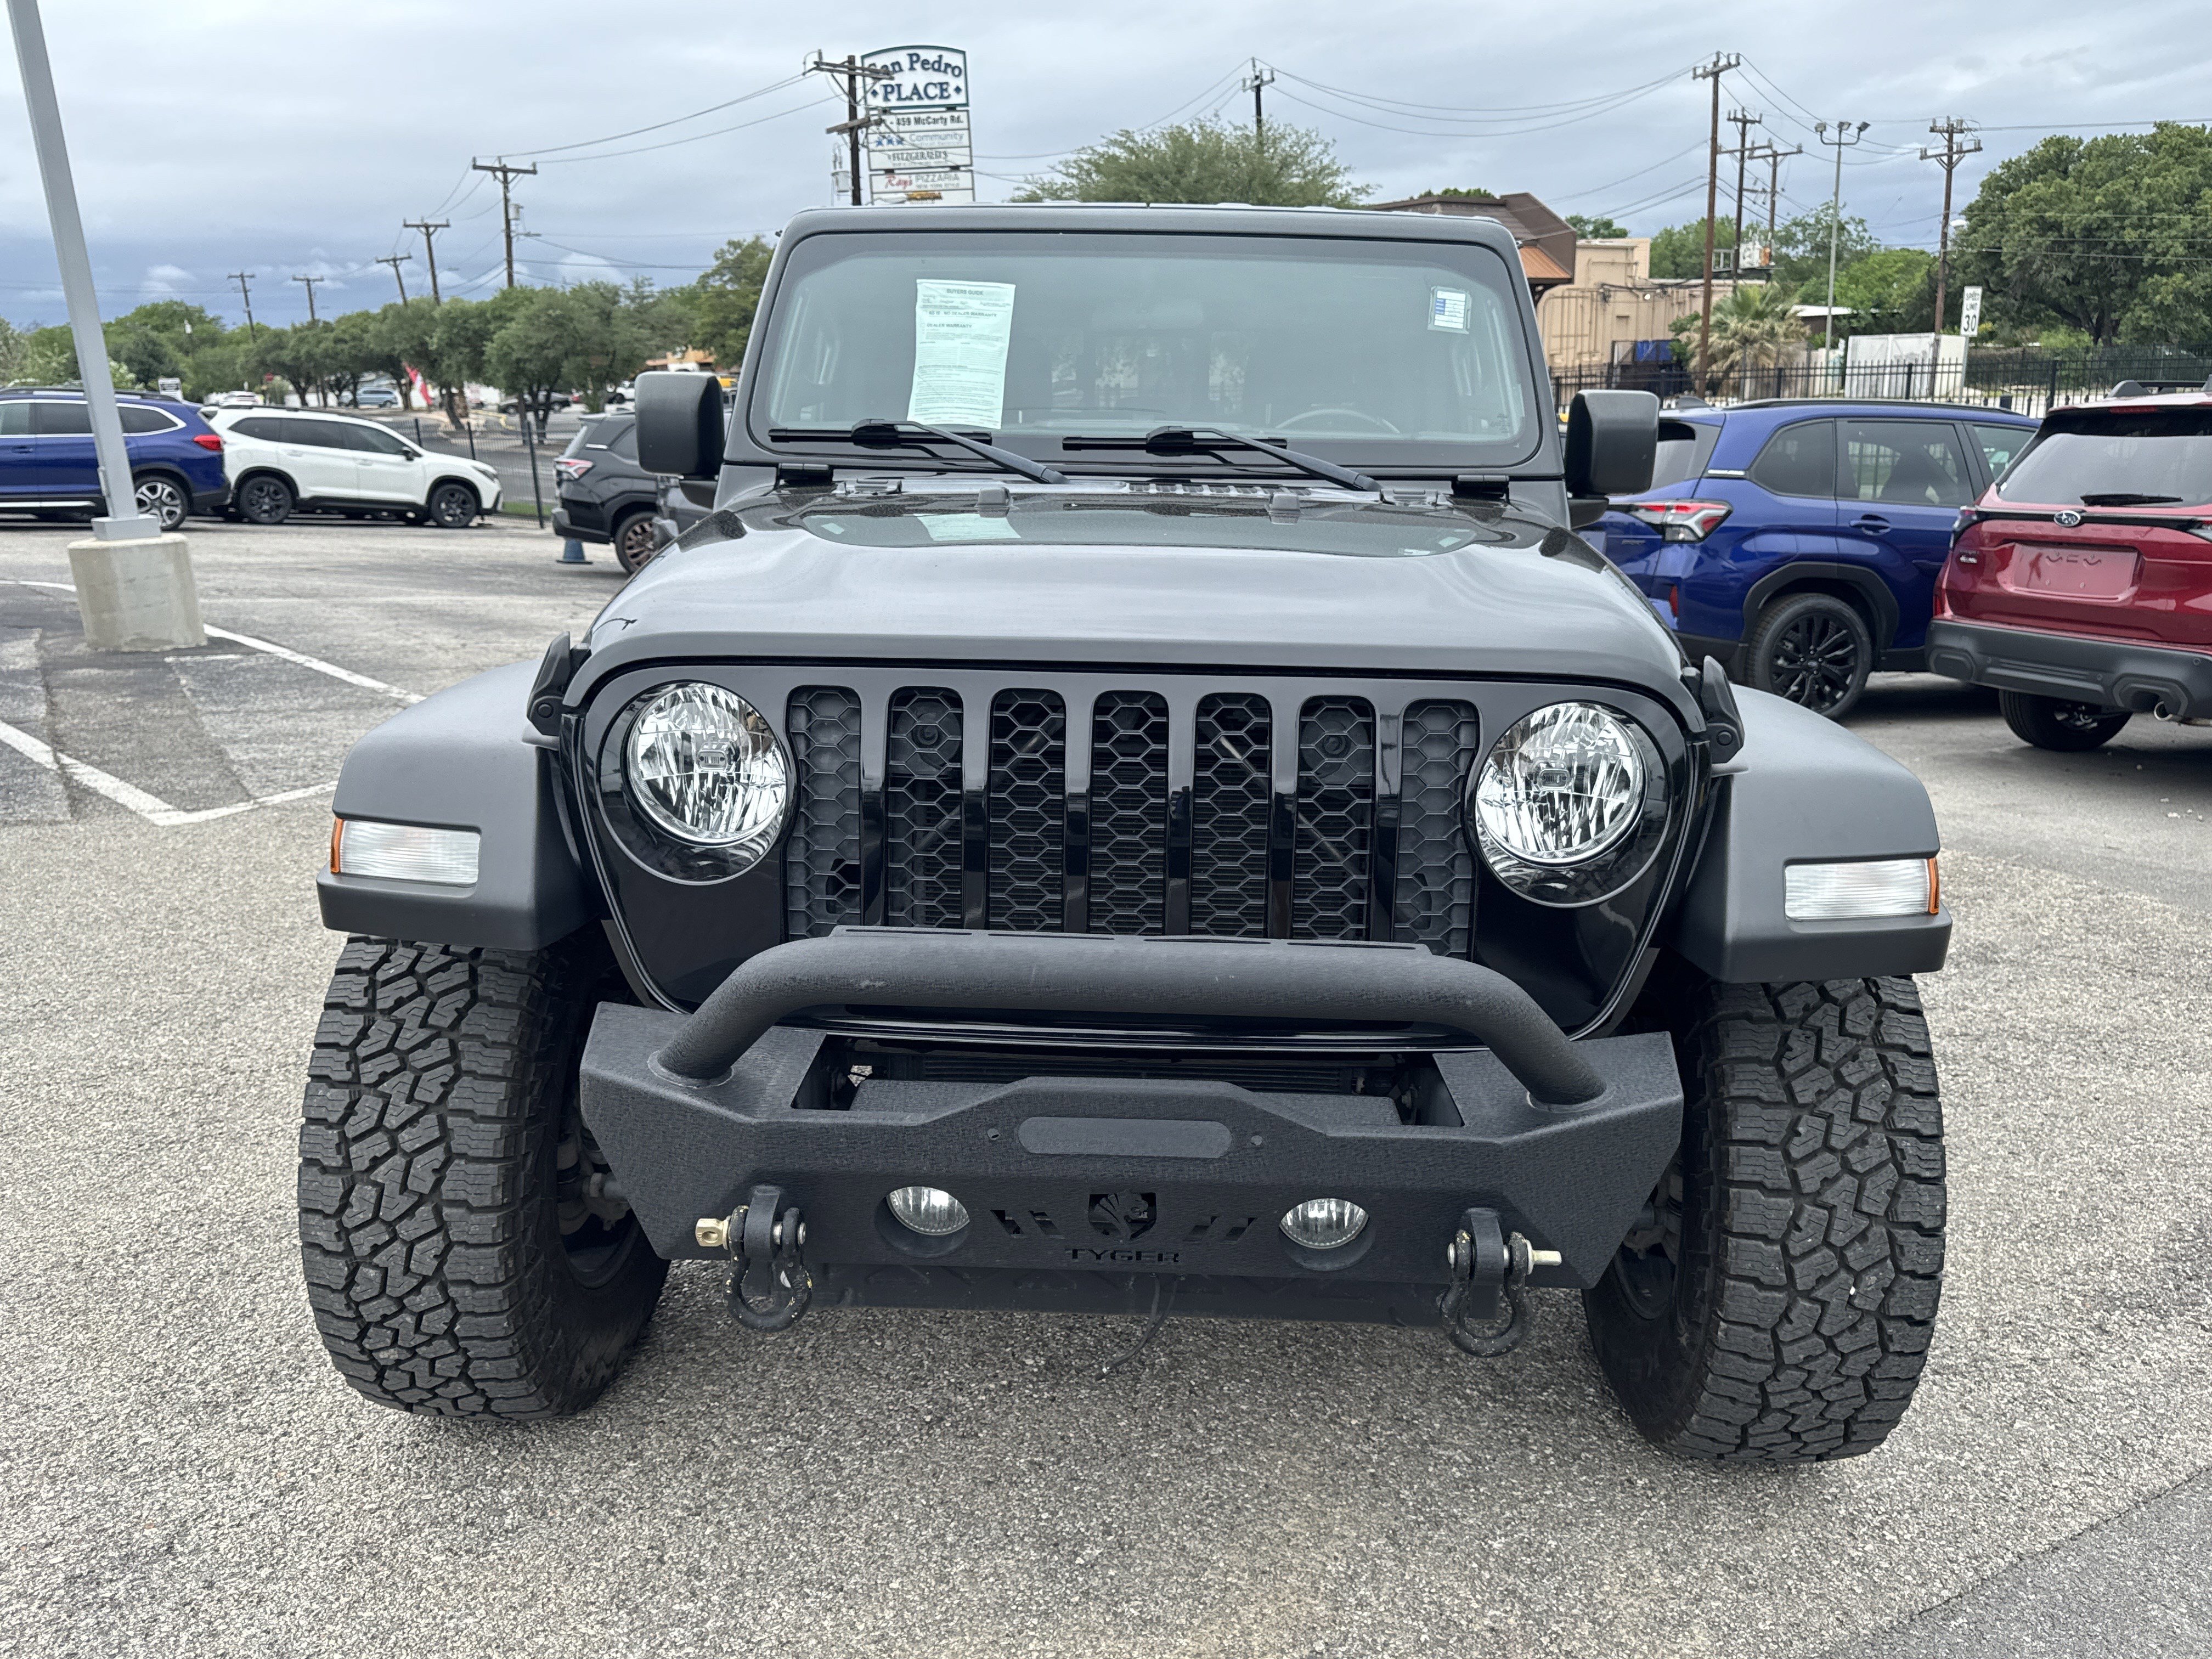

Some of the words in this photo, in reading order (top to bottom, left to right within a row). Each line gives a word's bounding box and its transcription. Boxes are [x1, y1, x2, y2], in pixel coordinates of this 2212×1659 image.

[906, 53, 962, 77] Pedro
[881, 82, 951, 101] PLACE
[913, 116, 947, 126] McCarty
[950, 115, 964, 123] Rd.
[909, 132, 964, 142] Community
[1963, 314, 1977, 332] 30
[1065, 1248, 1180, 1262] TYGER
